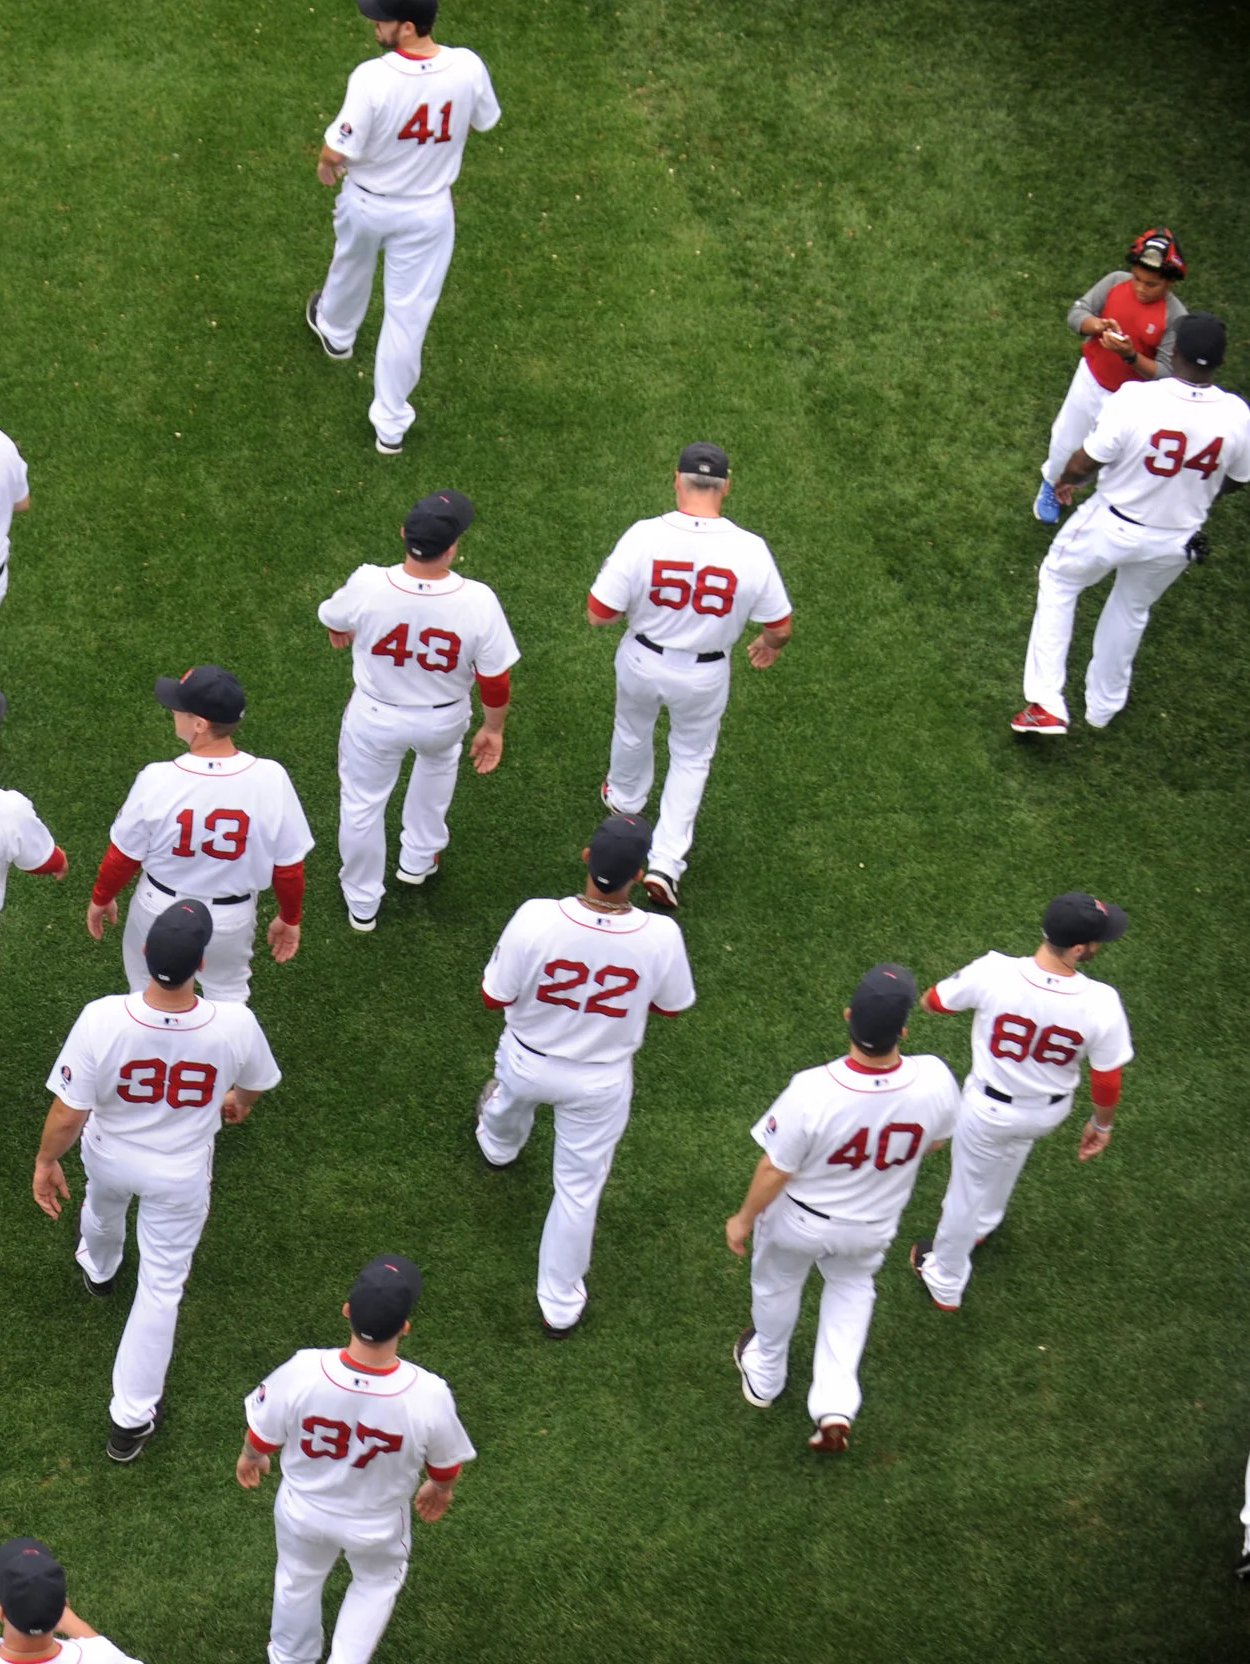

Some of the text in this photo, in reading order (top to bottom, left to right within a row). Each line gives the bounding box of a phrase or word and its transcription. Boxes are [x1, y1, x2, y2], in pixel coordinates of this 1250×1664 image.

[399, 102, 452, 143] 41
[1145, 429, 1224, 480] 34
[650, 560, 738, 616] 58
[372, 624, 461, 672] 43
[174, 809, 249, 860] 13
[538, 960, 638, 1016] 22
[991, 1014, 1083, 1062] 86
[118, 1059, 216, 1108] 38
[830, 1124, 923, 1169] 40
[302, 1417, 402, 1467] 37
